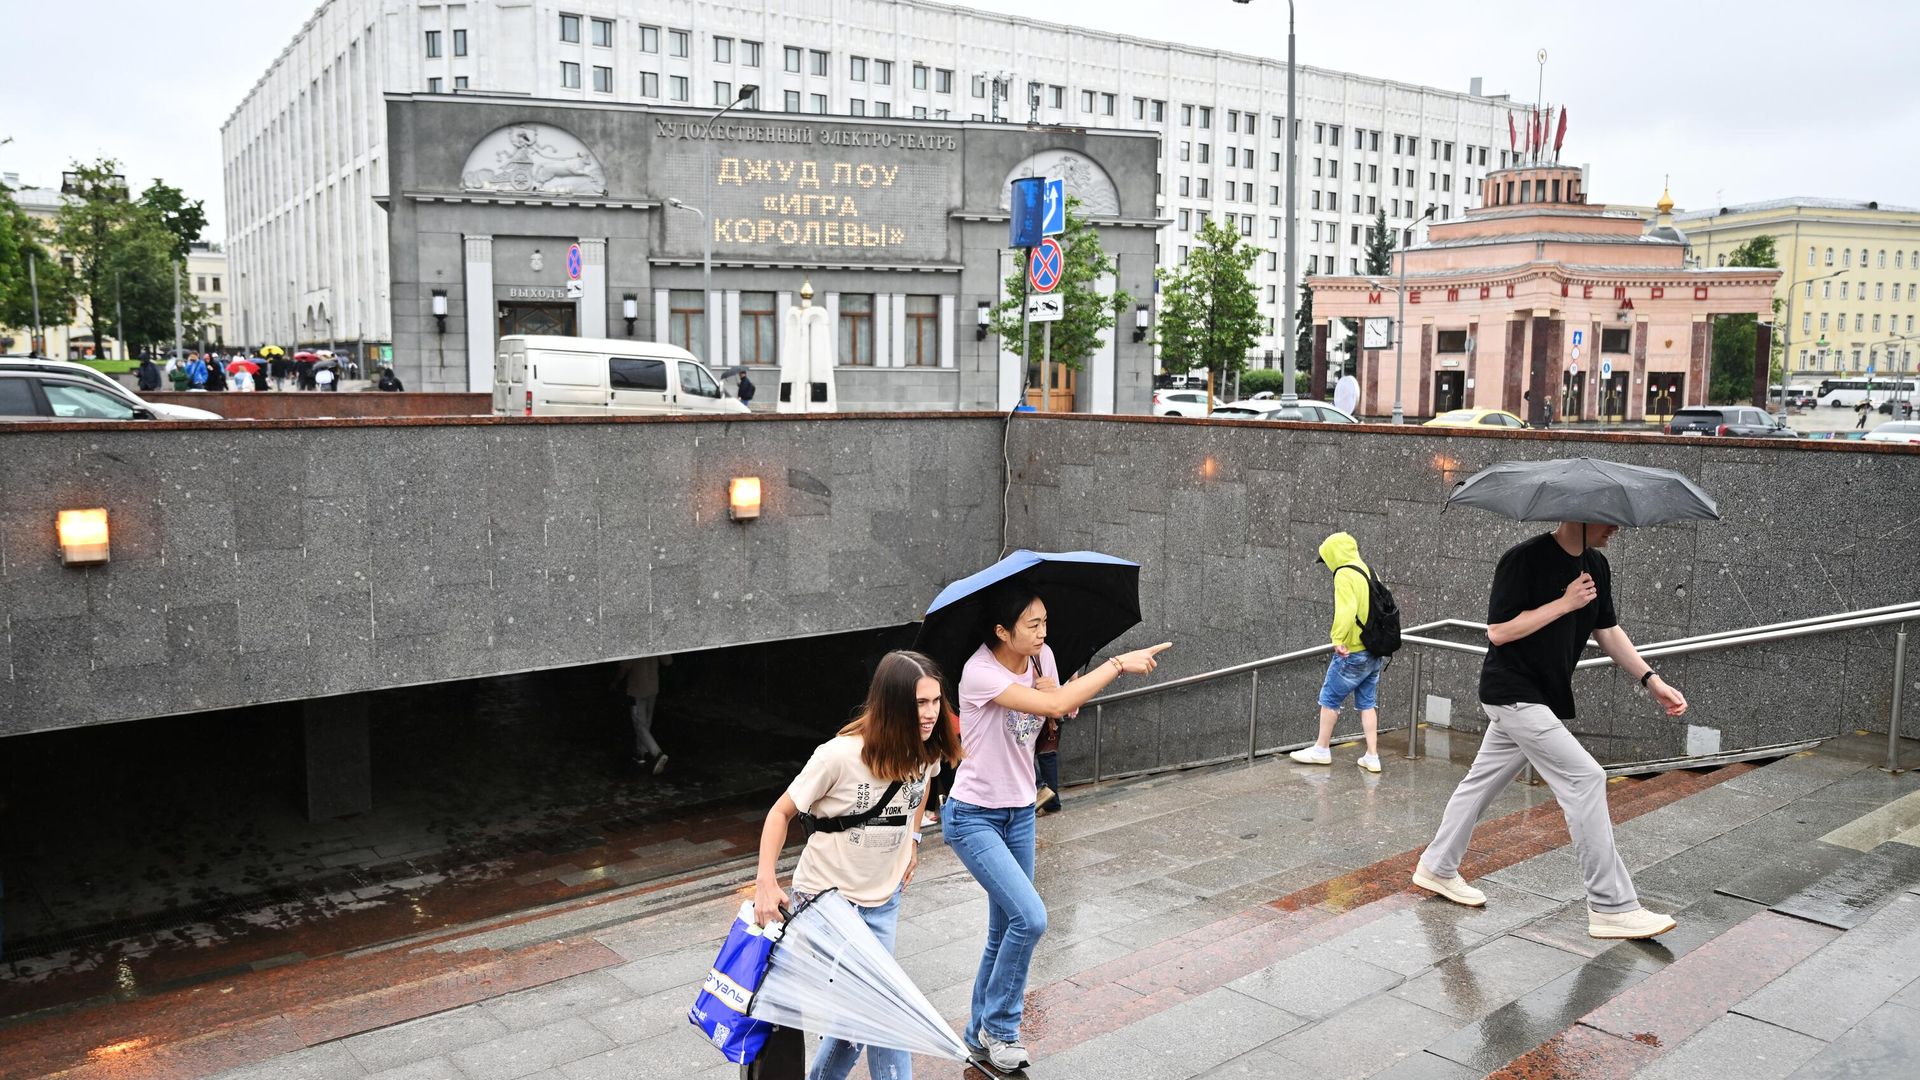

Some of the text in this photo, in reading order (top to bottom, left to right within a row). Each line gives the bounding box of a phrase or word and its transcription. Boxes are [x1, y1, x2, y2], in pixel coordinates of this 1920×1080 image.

[656, 121, 957, 150] ХУДОЖЕСТВЕННЫЙ ЭЛЕКТРО-ТЕАТРЪ
[717, 157, 898, 189] ДЖУД ЛОУ
[763, 193, 858, 217] «ИГРА
[714, 217, 904, 247] КОРОЛЕВЫ»
[510, 288, 564, 298] ВЫХОДЪ
[884, 806, 903, 815] YORK
